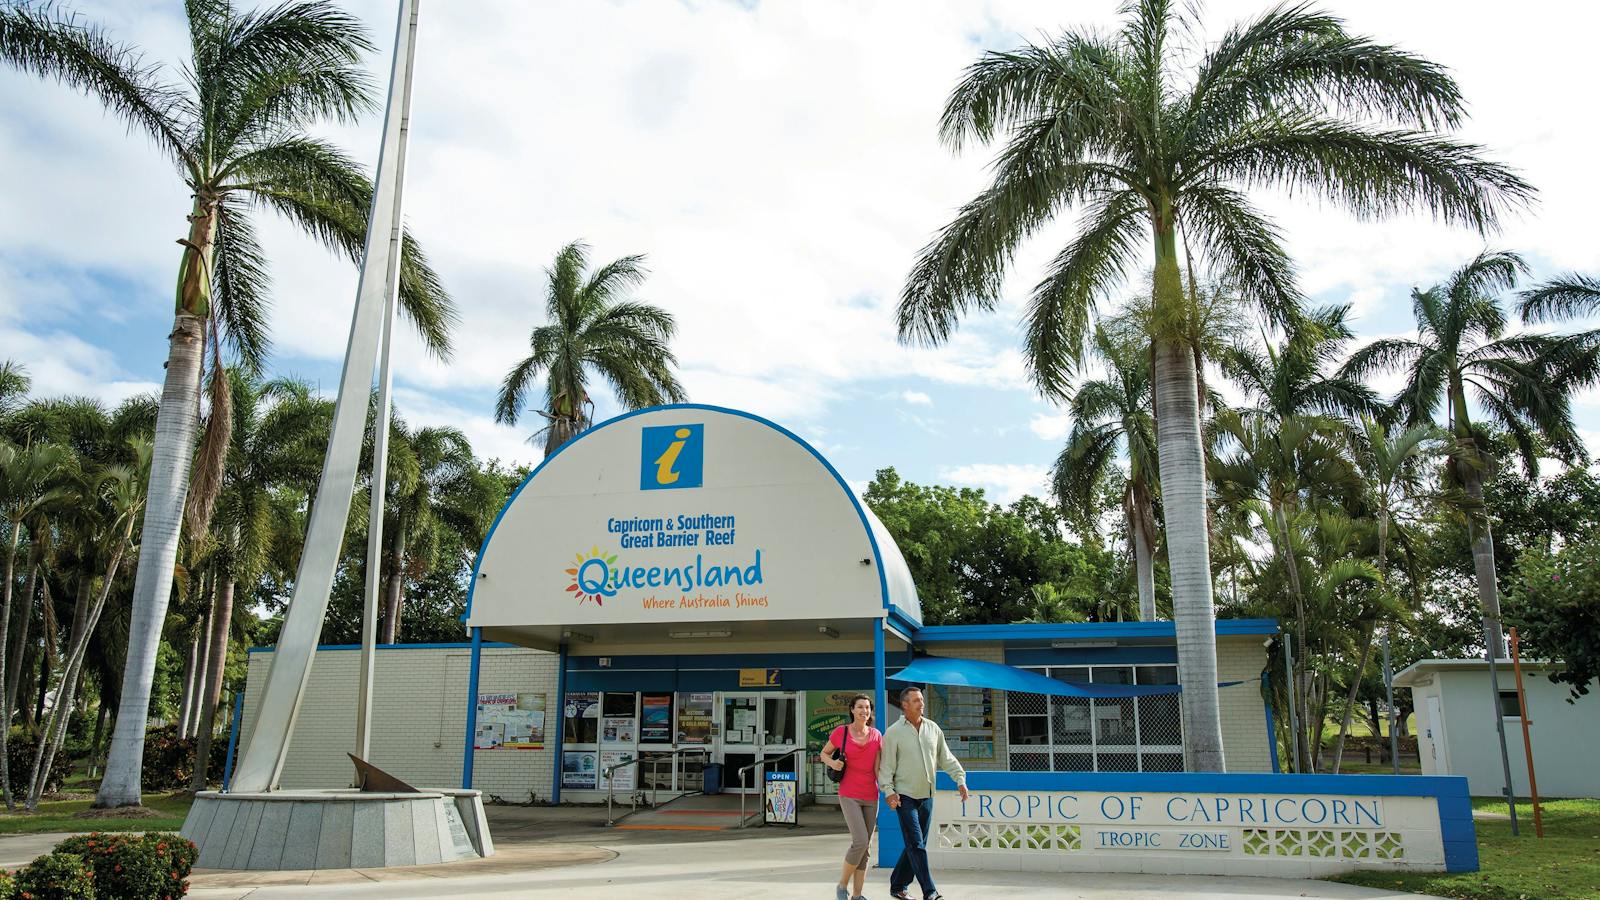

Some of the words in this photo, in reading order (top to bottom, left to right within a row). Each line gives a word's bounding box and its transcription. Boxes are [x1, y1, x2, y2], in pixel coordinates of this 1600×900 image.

[607, 516, 663, 534] Capricorn
[666, 518, 673, 530] &
[677, 513, 735, 531] Southern
[620, 531, 654, 548] Great
[657, 530, 699, 548] Barrier
[705, 529, 735, 546] Reef
[578, 548, 763, 597] Queensland
[642, 595, 675, 609] Where
[679, 593, 730, 609] Australia
[735, 592, 769, 608] Shines
[955, 794, 1079, 819] TROPIC
[1100, 795, 1143, 820] OF
[1166, 797, 1382, 826] CAPRICORN
[1097, 831, 1161, 847] TROPIC
[1179, 833, 1229, 848] ZONE
